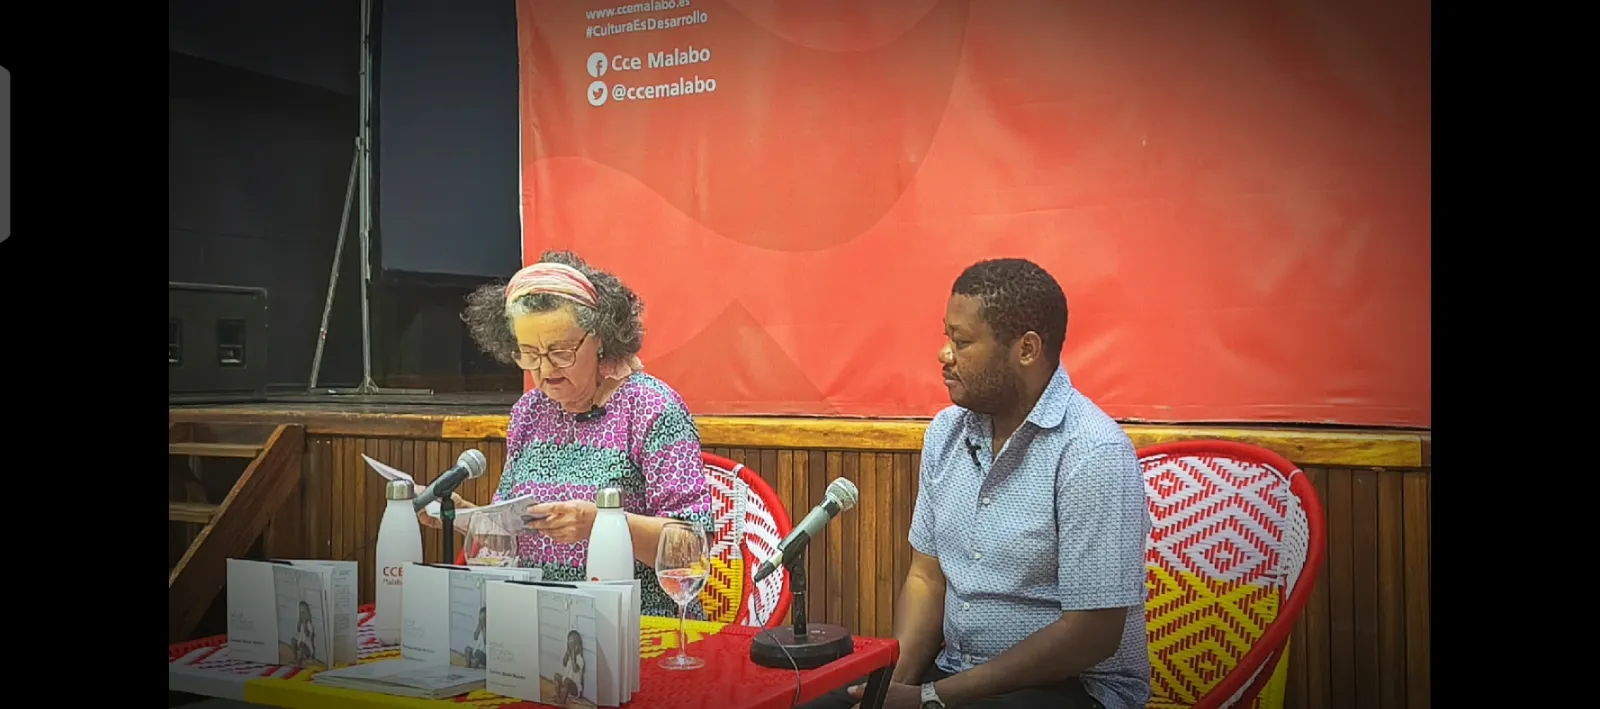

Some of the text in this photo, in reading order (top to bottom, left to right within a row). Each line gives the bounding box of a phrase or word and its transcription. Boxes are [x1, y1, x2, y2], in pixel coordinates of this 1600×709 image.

[585, 0, 690, 20] www.ccemalabo.es
[586, 10, 708, 38] #CulturaEsDesarrollo
[611, 46, 711, 71] Cce Malabo
[611, 75, 717, 101] @ccemalabo
